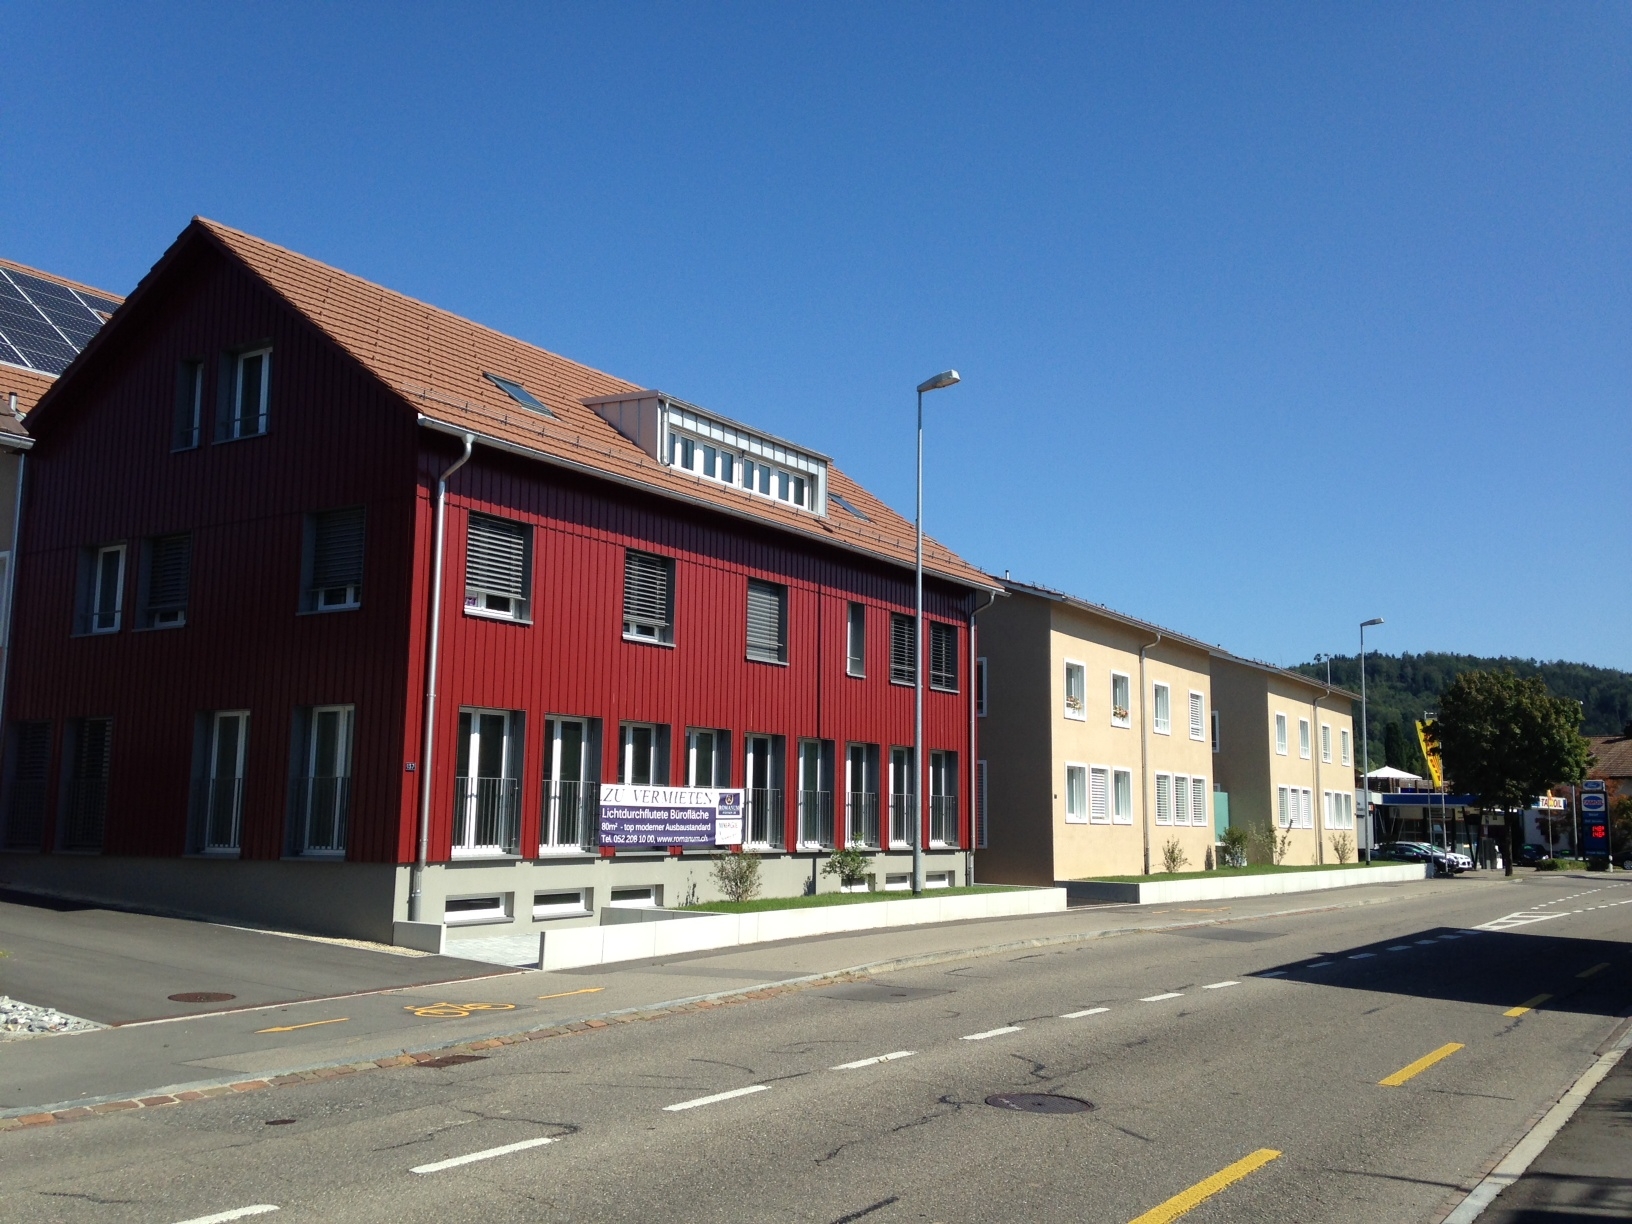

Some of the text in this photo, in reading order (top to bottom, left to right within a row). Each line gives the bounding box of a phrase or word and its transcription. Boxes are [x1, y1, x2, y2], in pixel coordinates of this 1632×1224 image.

[603, 788, 713, 805] ZU VERMIETEN
[1541, 798, 1562, 808] TAOIL
[602, 807, 710, 820] Lichtdurchflutete Bürofläche
[624, 823, 635, 833] top
[635, 823, 665, 831] moderner
[665, 823, 711, 831] Ausbaustandard
[601, 834, 612, 843] Tel.
[613, 834, 625, 843] 052
[626, 835, 637, 843] 208
[638, 835, 646, 843] 10
[656, 834, 708, 843] www.romanum.ch
